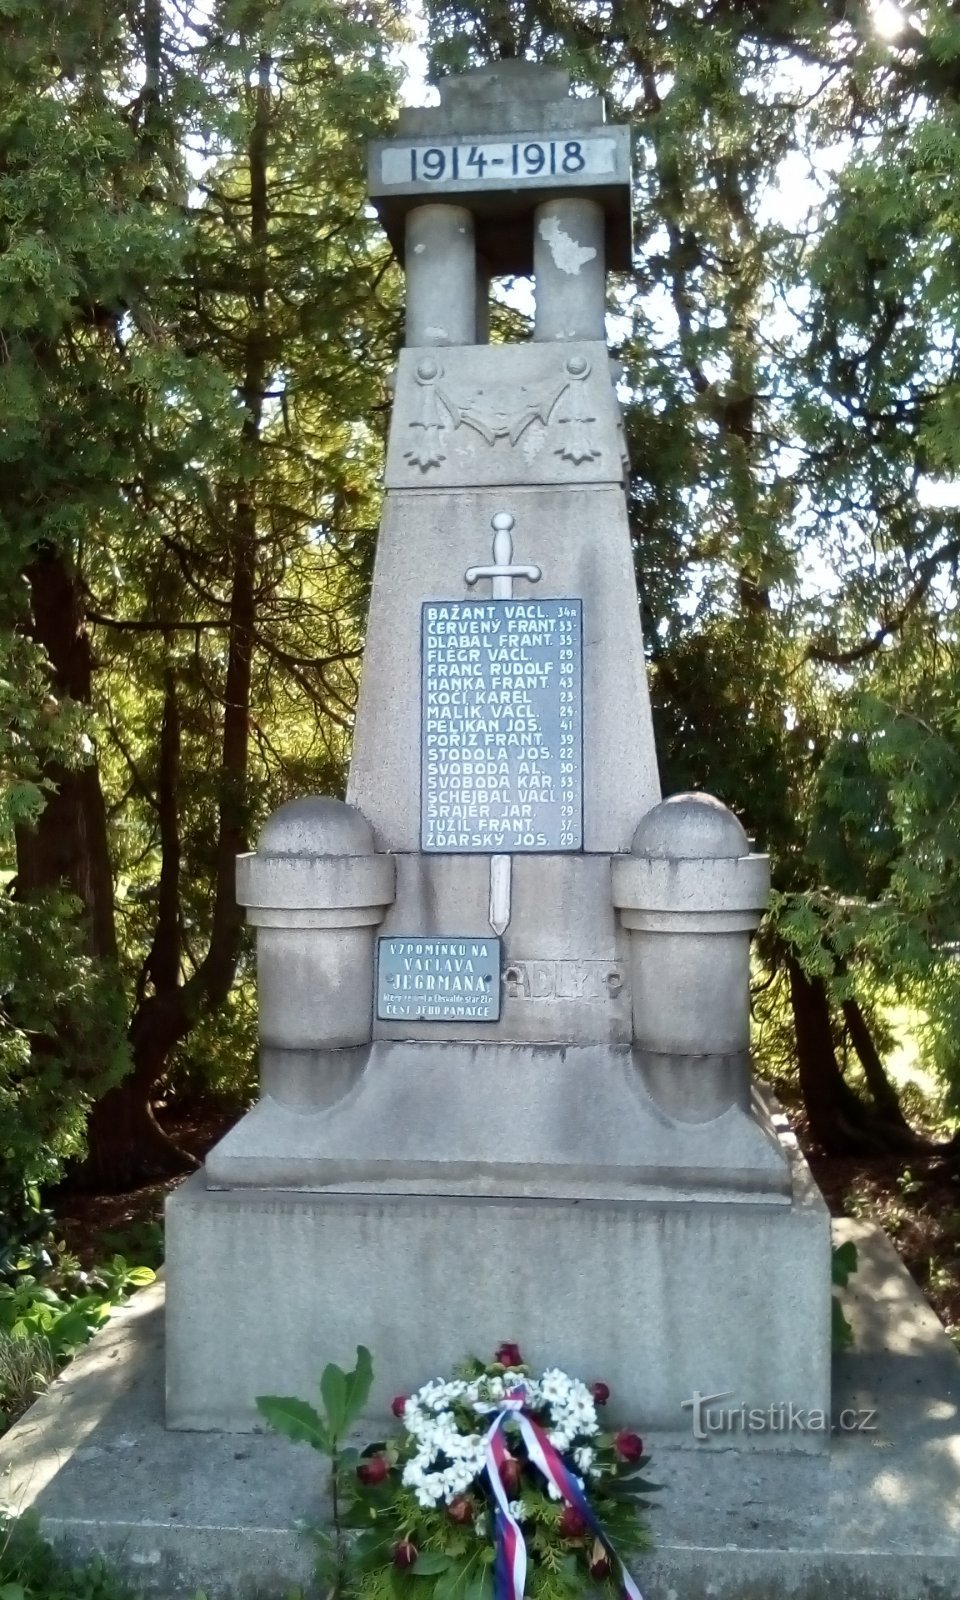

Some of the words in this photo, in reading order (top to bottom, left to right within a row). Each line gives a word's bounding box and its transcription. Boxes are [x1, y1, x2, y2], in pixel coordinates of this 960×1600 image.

[410, 141, 586, 181] 1914-1918
[428, 605, 497, 620] BAŽANT
[428, 620, 501, 634] ČERVENÝ
[508, 619, 557, 633] FRANT.
[428, 636, 492, 648] DLABAL
[499, 634, 553, 647] FRANT.
[488, 646, 532, 661] VÁCL.
[428, 664, 482, 676] FRANC
[490, 662, 553, 675] RUDOLF
[428, 677, 486, 690] HANKA
[492, 676, 549, 689] FRANT.
[428, 690, 468, 704] KOČÍ
[476, 690, 532, 704] KAREL
[428, 703, 482, 718] MALÍK
[491, 704, 540, 718] VÁCL.
[505, 720, 542, 732] JOS.
[428, 731, 478, 746] POŘÍZ
[485, 733, 544, 746] FRANT.
[428, 748, 508, 761] STODOLA
[516, 747, 554, 760] JOS.
[428, 762, 509, 775] SVOBODA
[519, 761, 545, 774] AL.
[428, 776, 510, 789] SVOBODA
[517, 775, 555, 788] KAR.
[428, 790, 511, 805] SCHEJBAL
[501, 804, 537, 817] JAR.
[428, 817, 471, 832] TUŽIL
[479, 818, 535, 831] FRANT.
[514, 834, 550, 846] JOS.
[390, 941, 466, 956] VZPOMÍNKU
[472, 944, 488, 957] NA
